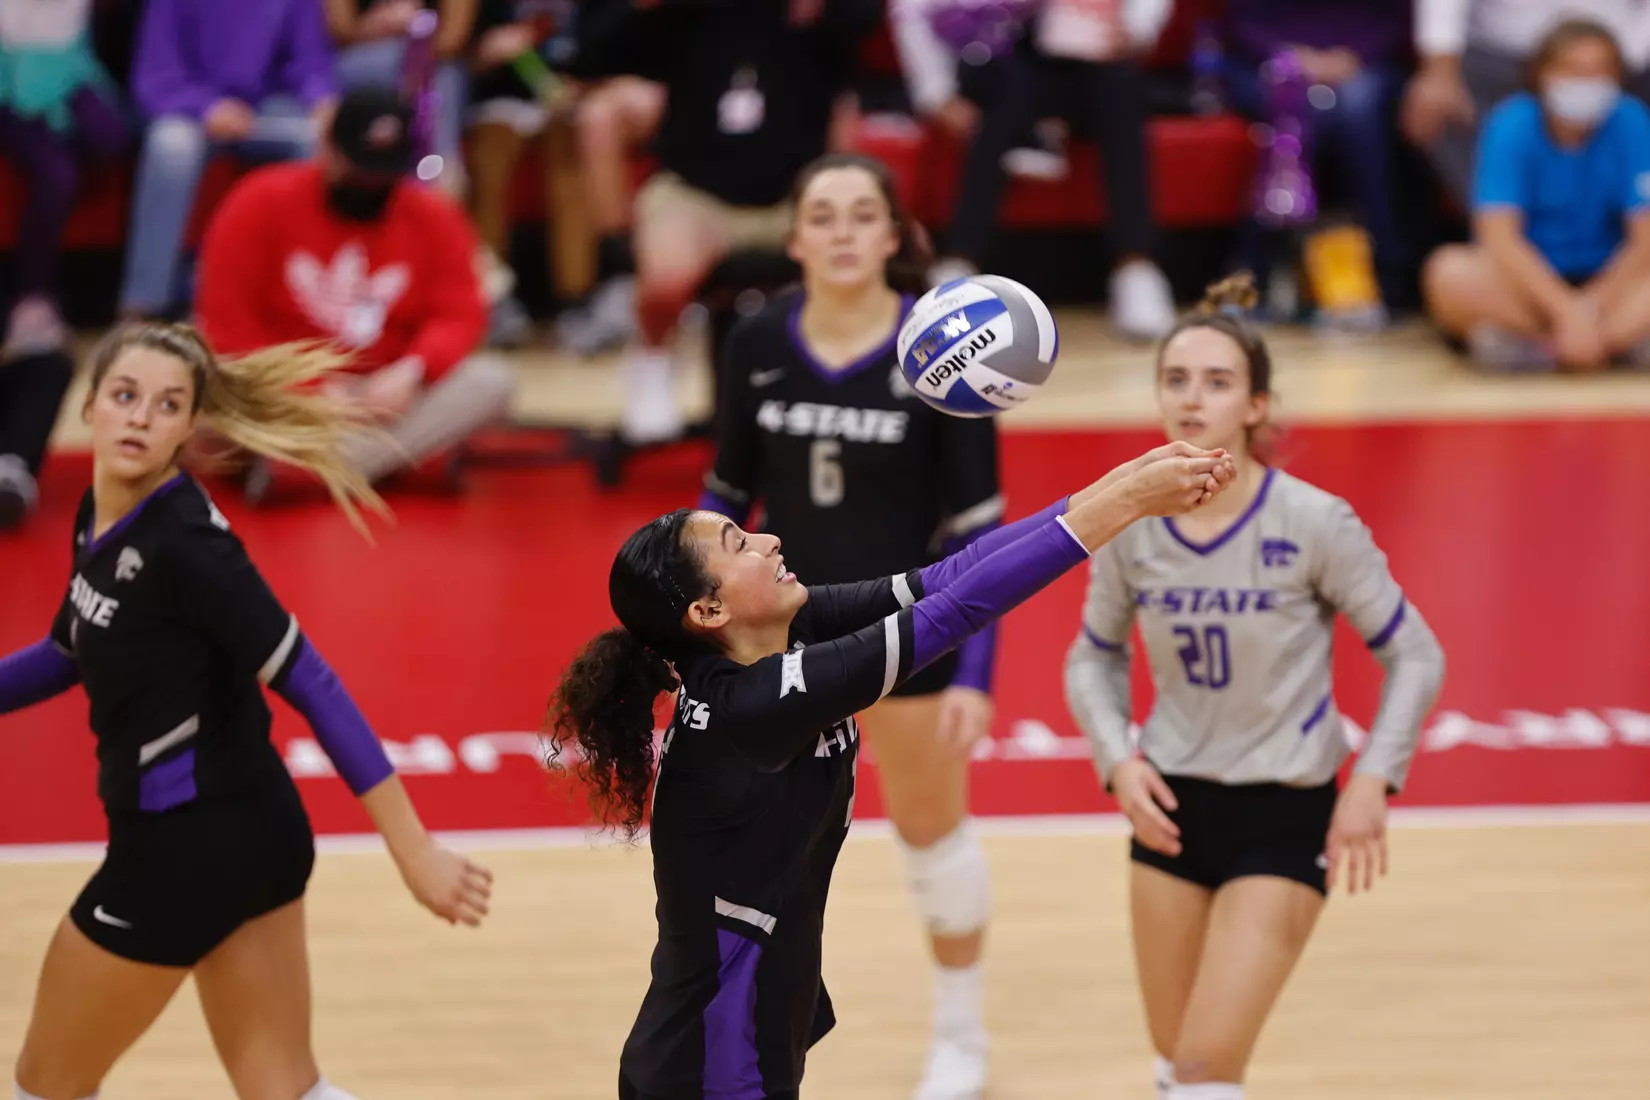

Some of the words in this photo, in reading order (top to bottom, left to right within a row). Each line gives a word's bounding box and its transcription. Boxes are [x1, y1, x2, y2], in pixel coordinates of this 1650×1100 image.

[925, 328, 996, 387] molten
[809, 438, 844, 507] 6
[1173, 625, 1231, 689] 20
